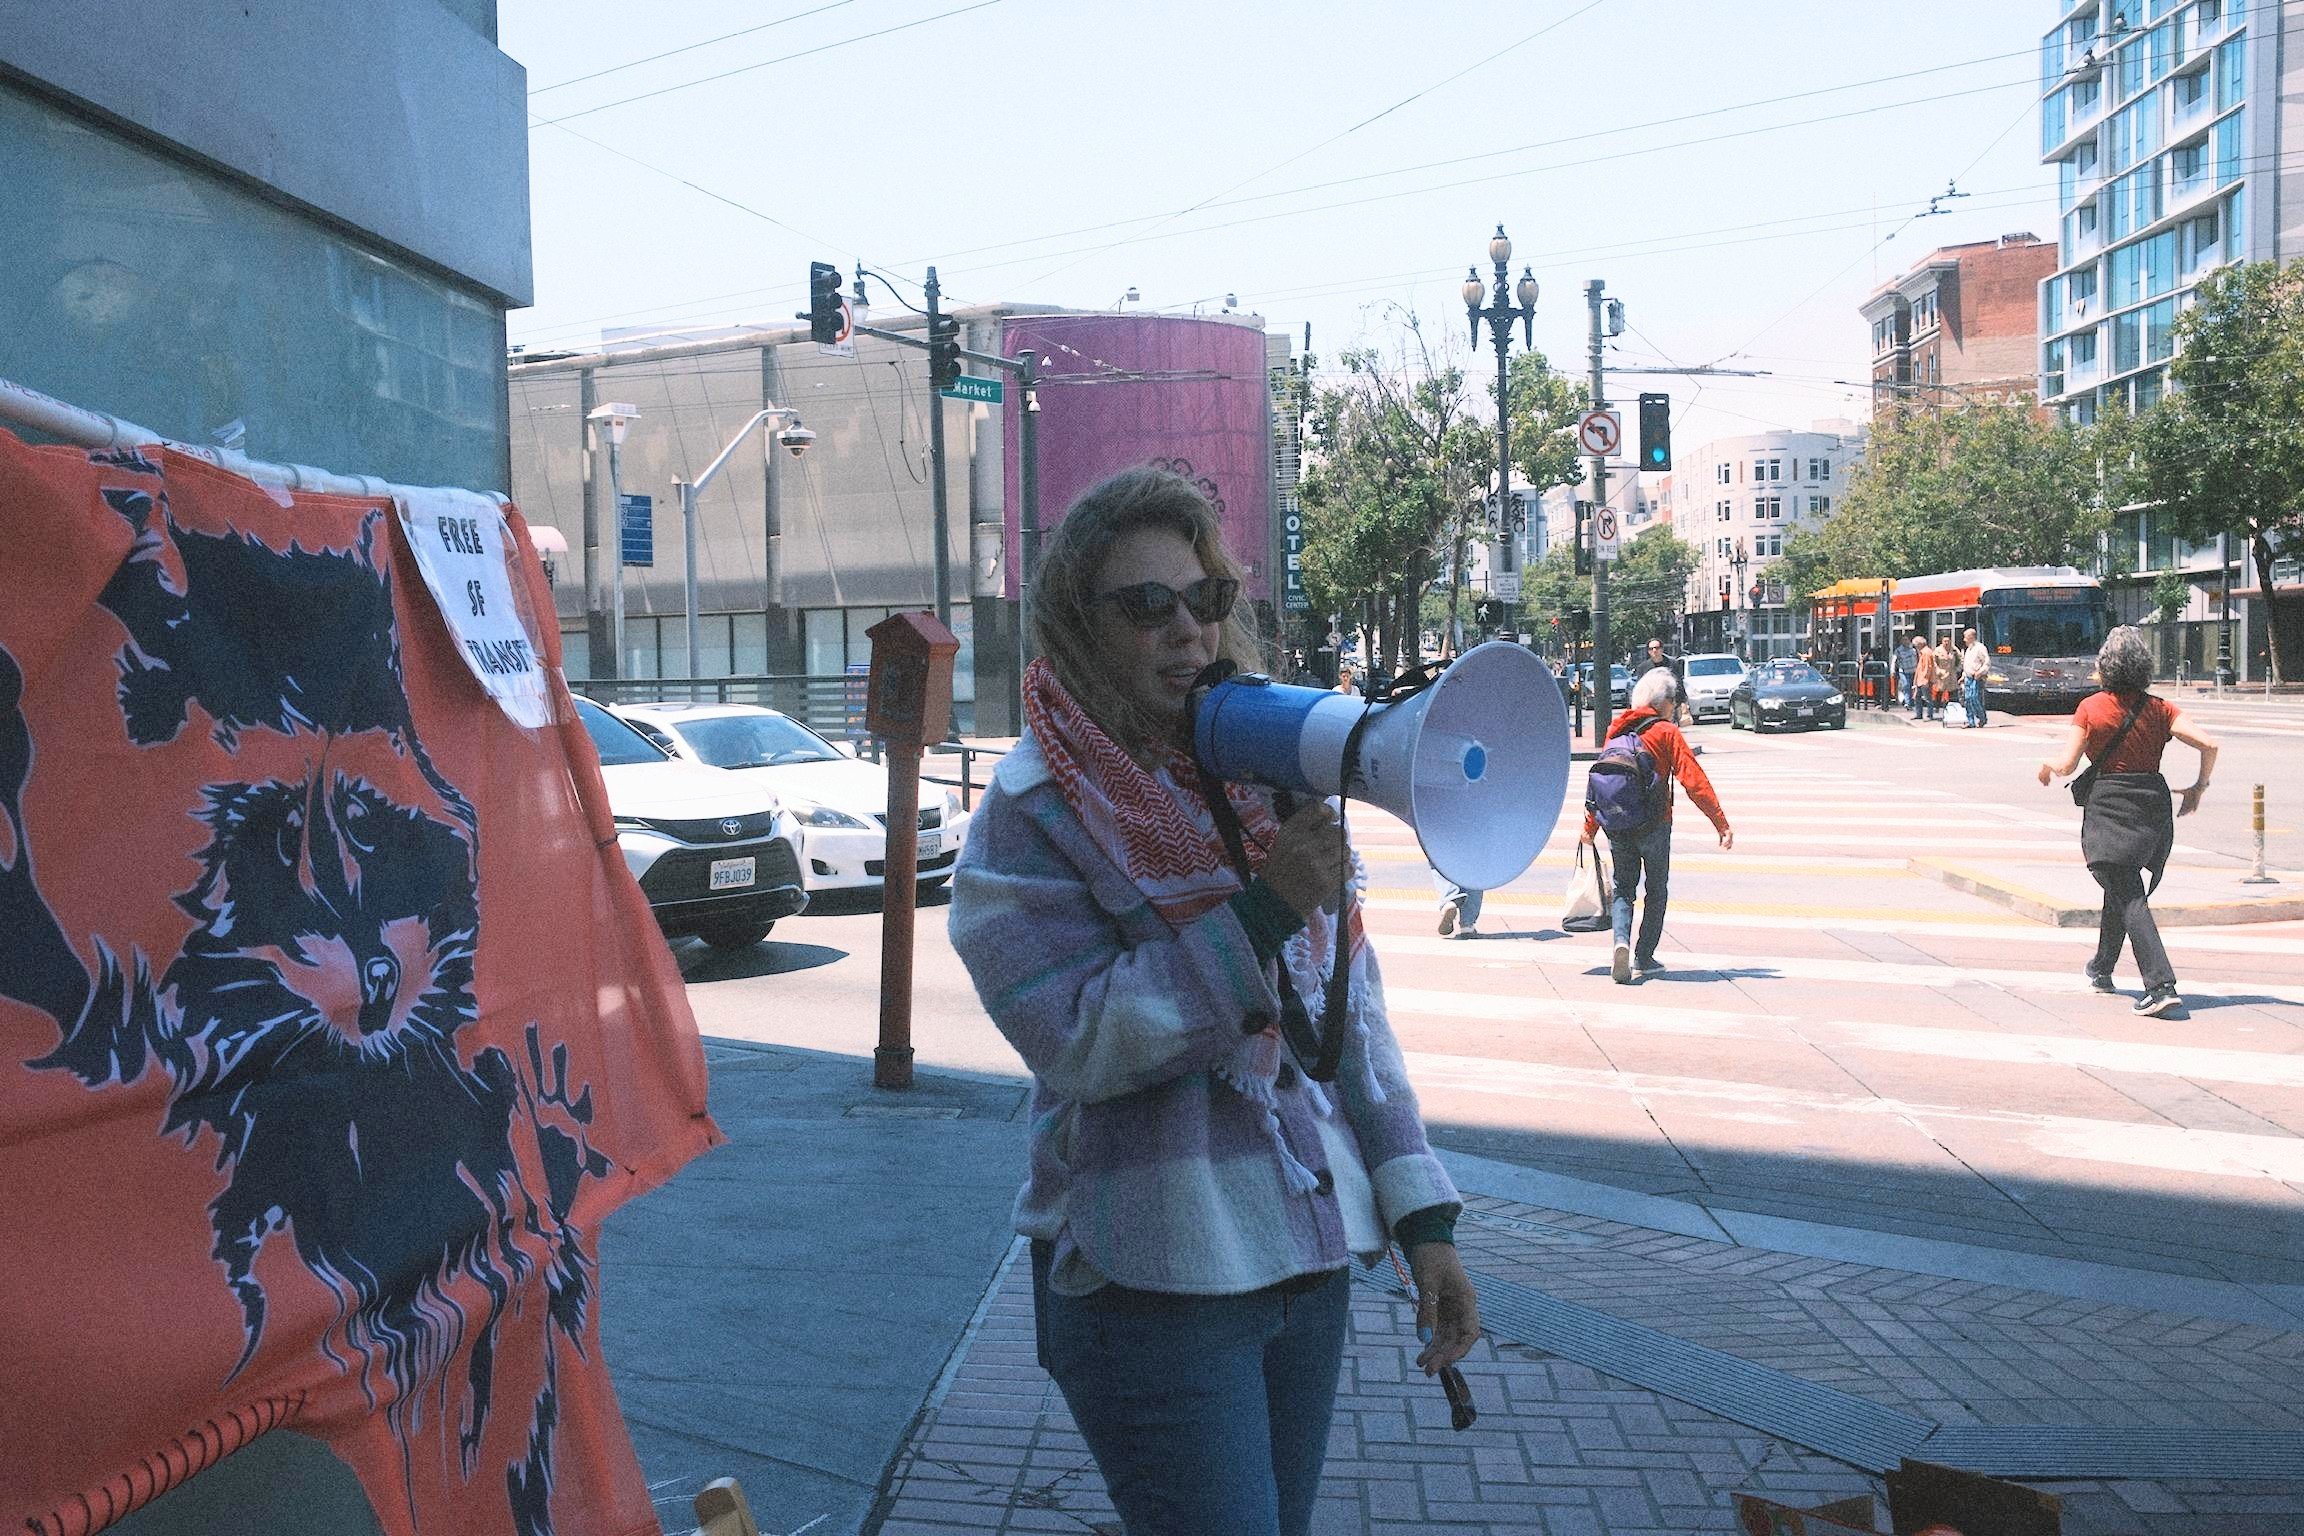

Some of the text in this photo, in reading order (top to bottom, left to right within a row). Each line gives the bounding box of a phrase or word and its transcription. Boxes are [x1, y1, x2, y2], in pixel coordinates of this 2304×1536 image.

[953, 382, 992, 398] Market
[438, 516, 484, 554] FREE
[1286, 496, 1301, 590] HOTEL
[466, 579, 485, 617] SF
[713, 868, 752, 886] 9FBJ039
